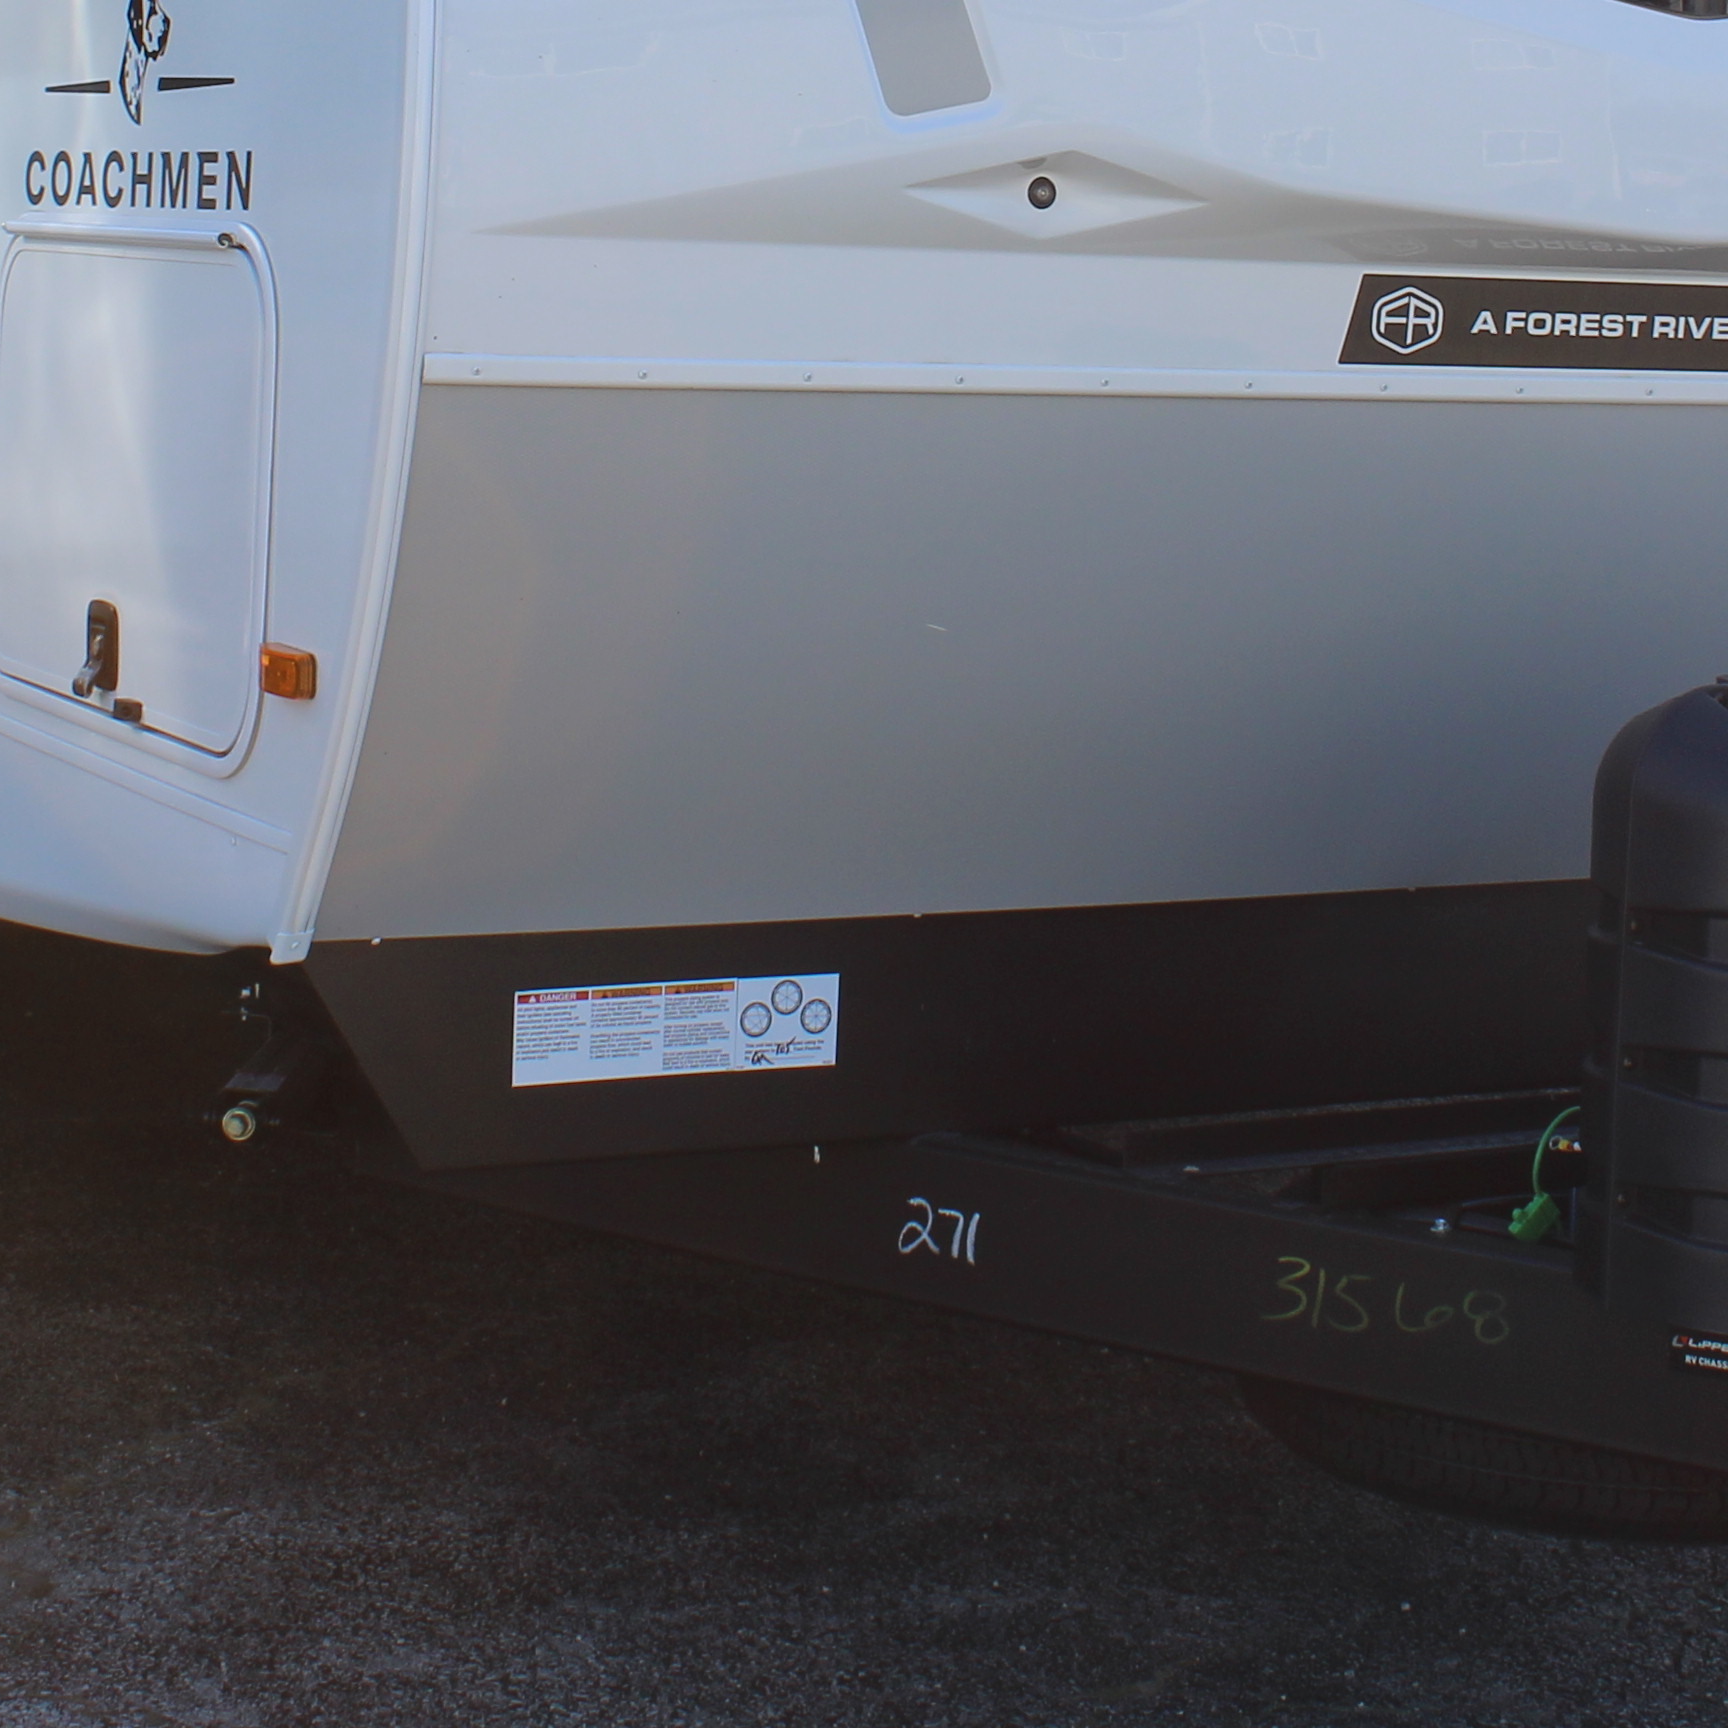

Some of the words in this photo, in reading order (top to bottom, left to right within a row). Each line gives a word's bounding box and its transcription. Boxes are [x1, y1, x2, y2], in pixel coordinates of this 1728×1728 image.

[25, 150, 253, 211] COACHMEN
[1469, 310, 1499, 335] A
[1504, 311, 1647, 339] FOREST
[897, 1197, 980, 1266] 271
[1684, 1354, 1697, 1365] RV
